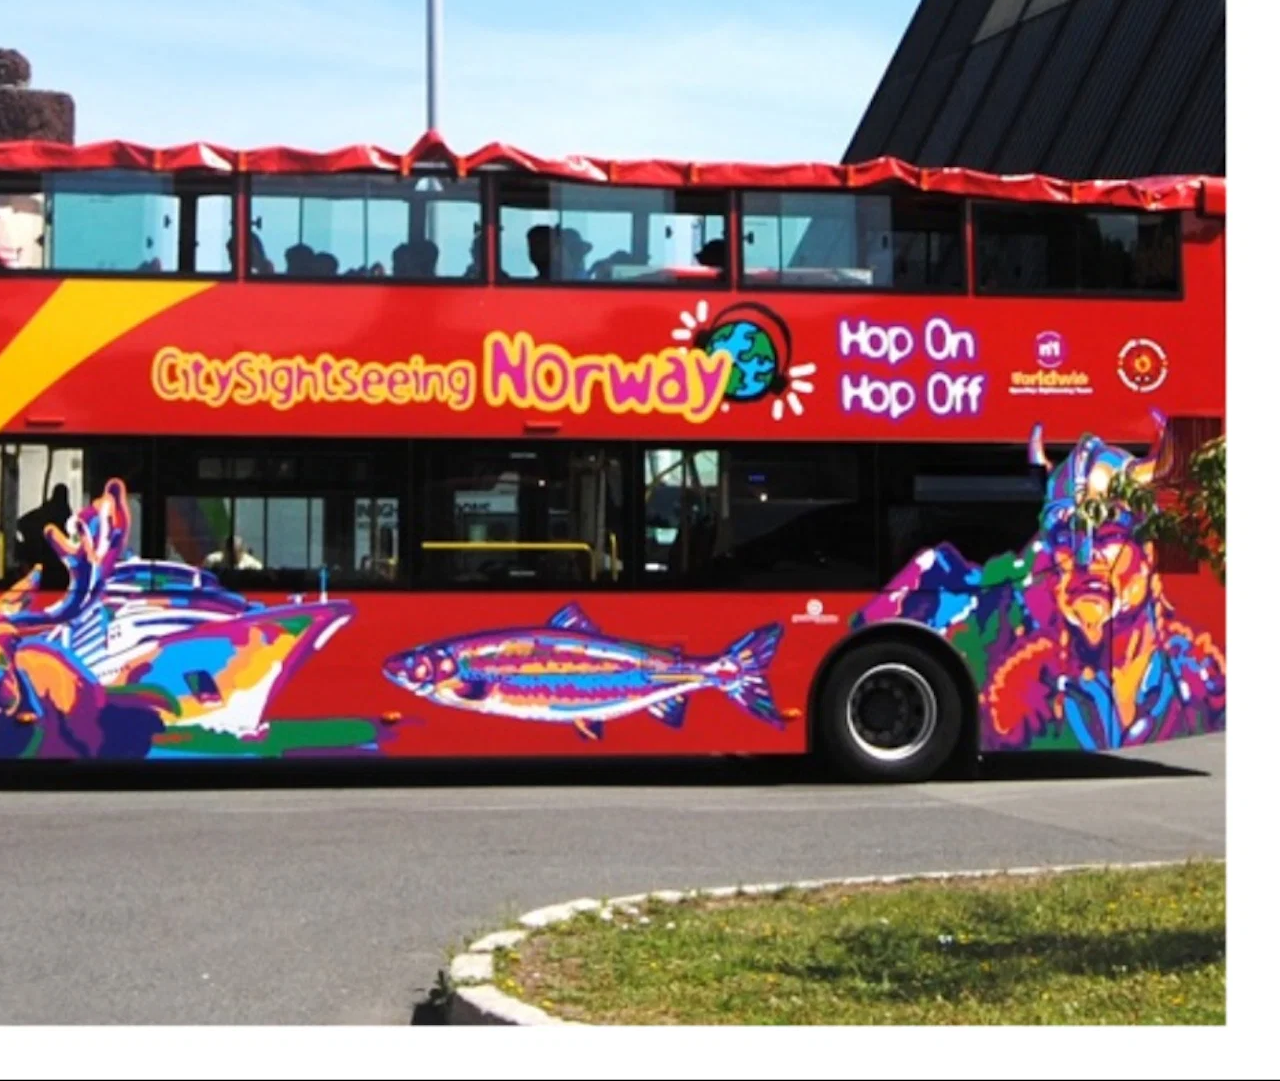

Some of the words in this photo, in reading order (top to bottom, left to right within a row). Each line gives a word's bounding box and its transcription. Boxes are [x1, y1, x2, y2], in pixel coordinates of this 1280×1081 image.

[840, 319, 915, 364] Hop
[925, 317, 975, 361] On
[153, 346, 476, 410] CitySightseeing
[483, 330, 733, 424] Norway
[841, 373, 916, 419] Hop
[926, 371, 985, 415] Off
